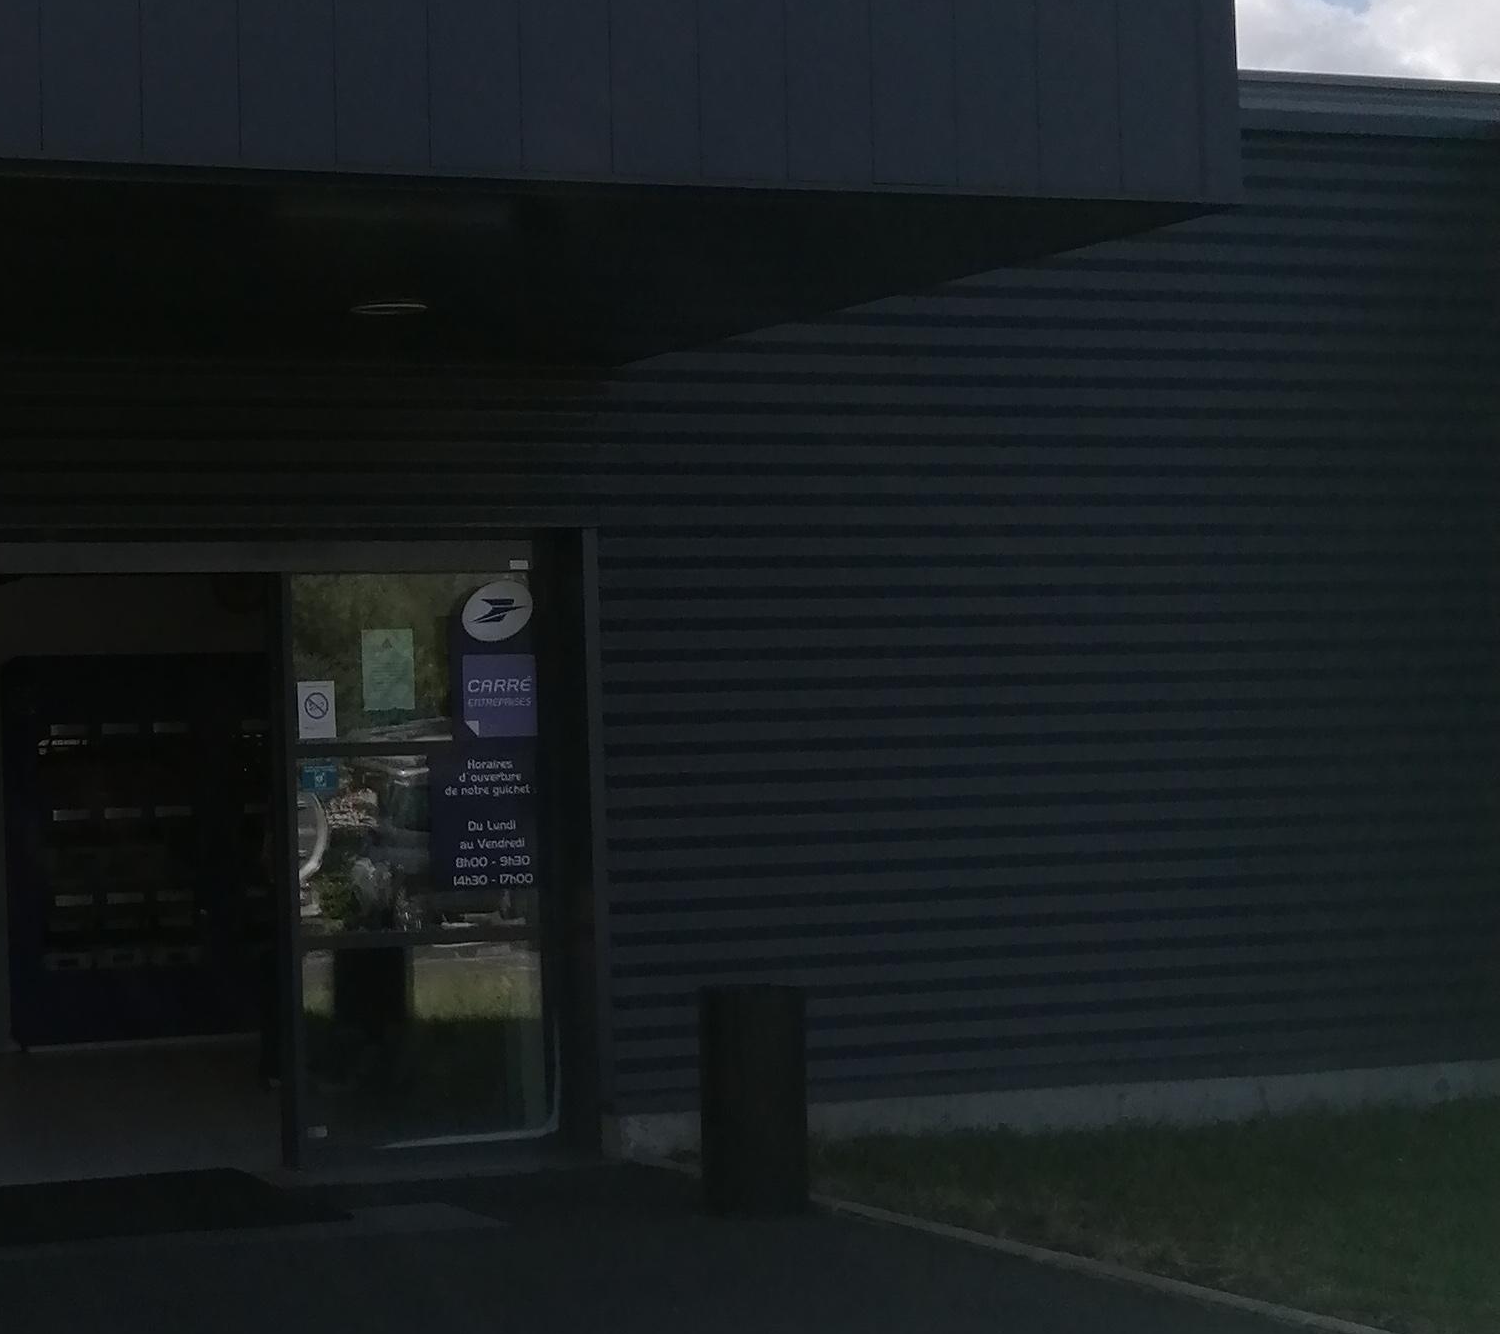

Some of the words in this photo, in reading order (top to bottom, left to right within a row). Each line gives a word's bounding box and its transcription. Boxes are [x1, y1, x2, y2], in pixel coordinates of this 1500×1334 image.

[467, 675, 533, 693] CARRÉ
[467, 758, 514, 770] Horaires
[444, 785, 458, 796] de
[461, 784, 490, 795] notre
[492, 783, 531, 797] guichet
[467, 820, 483, 832] Du
[486, 819, 517, 831] Lundi
[459, 840, 475, 850] au
[477, 836, 525, 849] Vendredi
[455, 855, 488, 868] 8h00
[499, 854, 531, 867] 9h30
[452, 874, 488, 886] 14h30
[499, 872, 534, 885] 17h00
